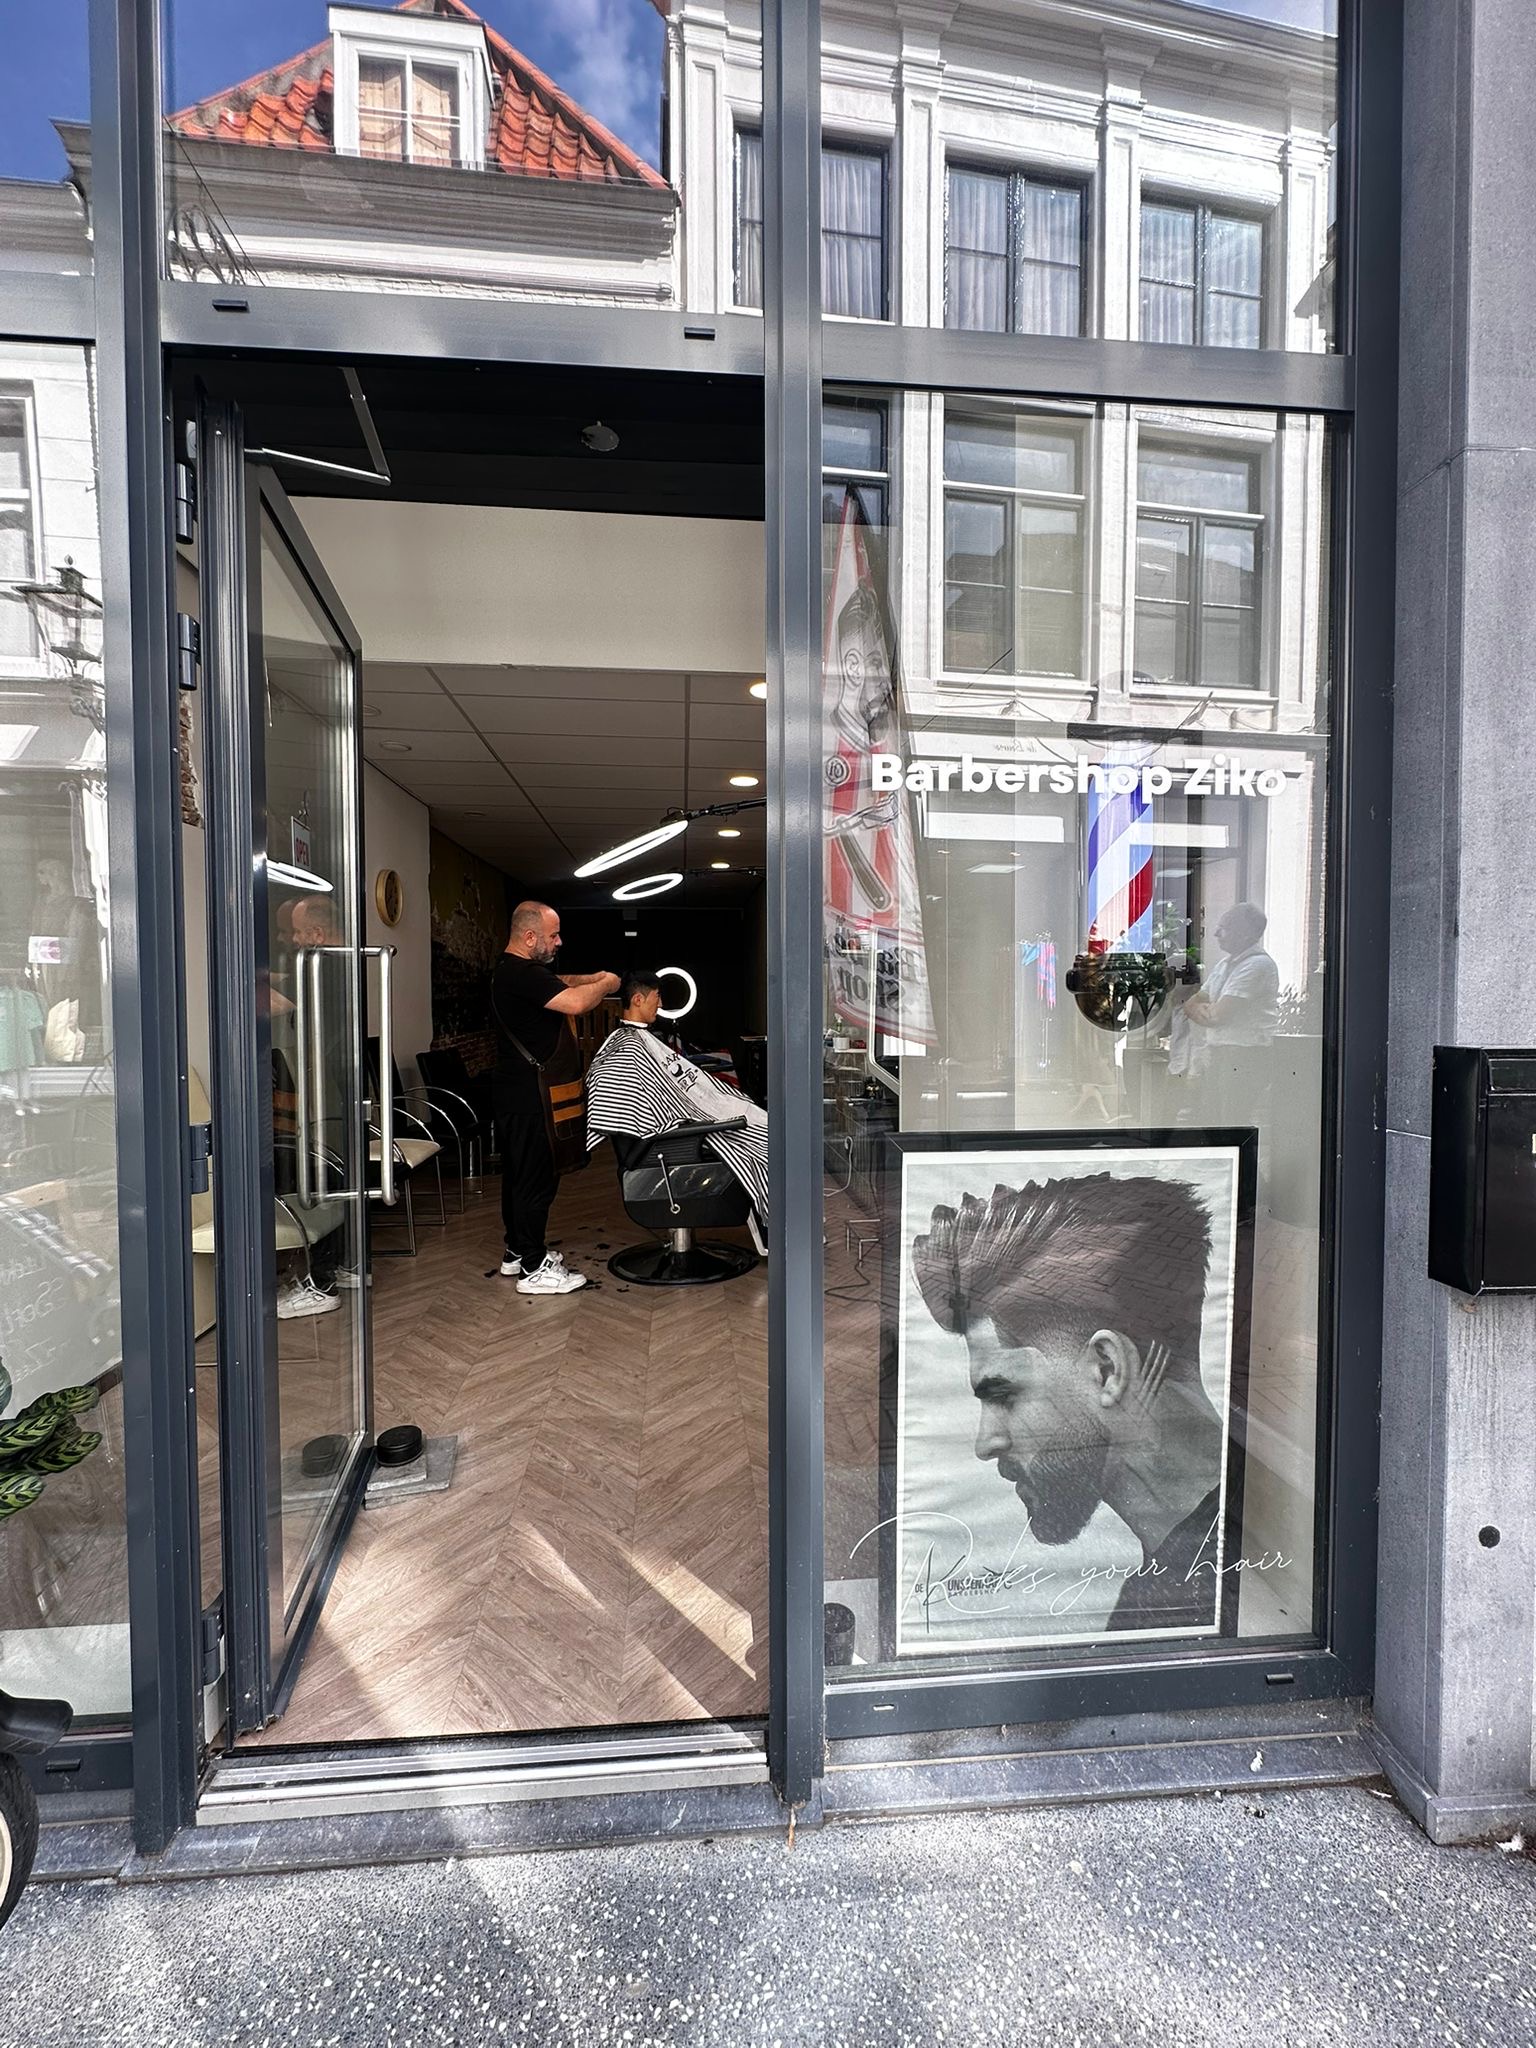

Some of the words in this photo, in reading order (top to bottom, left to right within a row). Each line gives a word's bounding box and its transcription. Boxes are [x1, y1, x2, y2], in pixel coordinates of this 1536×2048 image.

[871, 752, 1172, 804] Barbershop
[1183, 753, 1287, 797] Ziko
[296, 838, 310, 867] OPEN
[849, 1511, 1057, 1618] Rocks
[1050, 1553, 1169, 1616] your
[1185, 1511, 1293, 1582] hair
